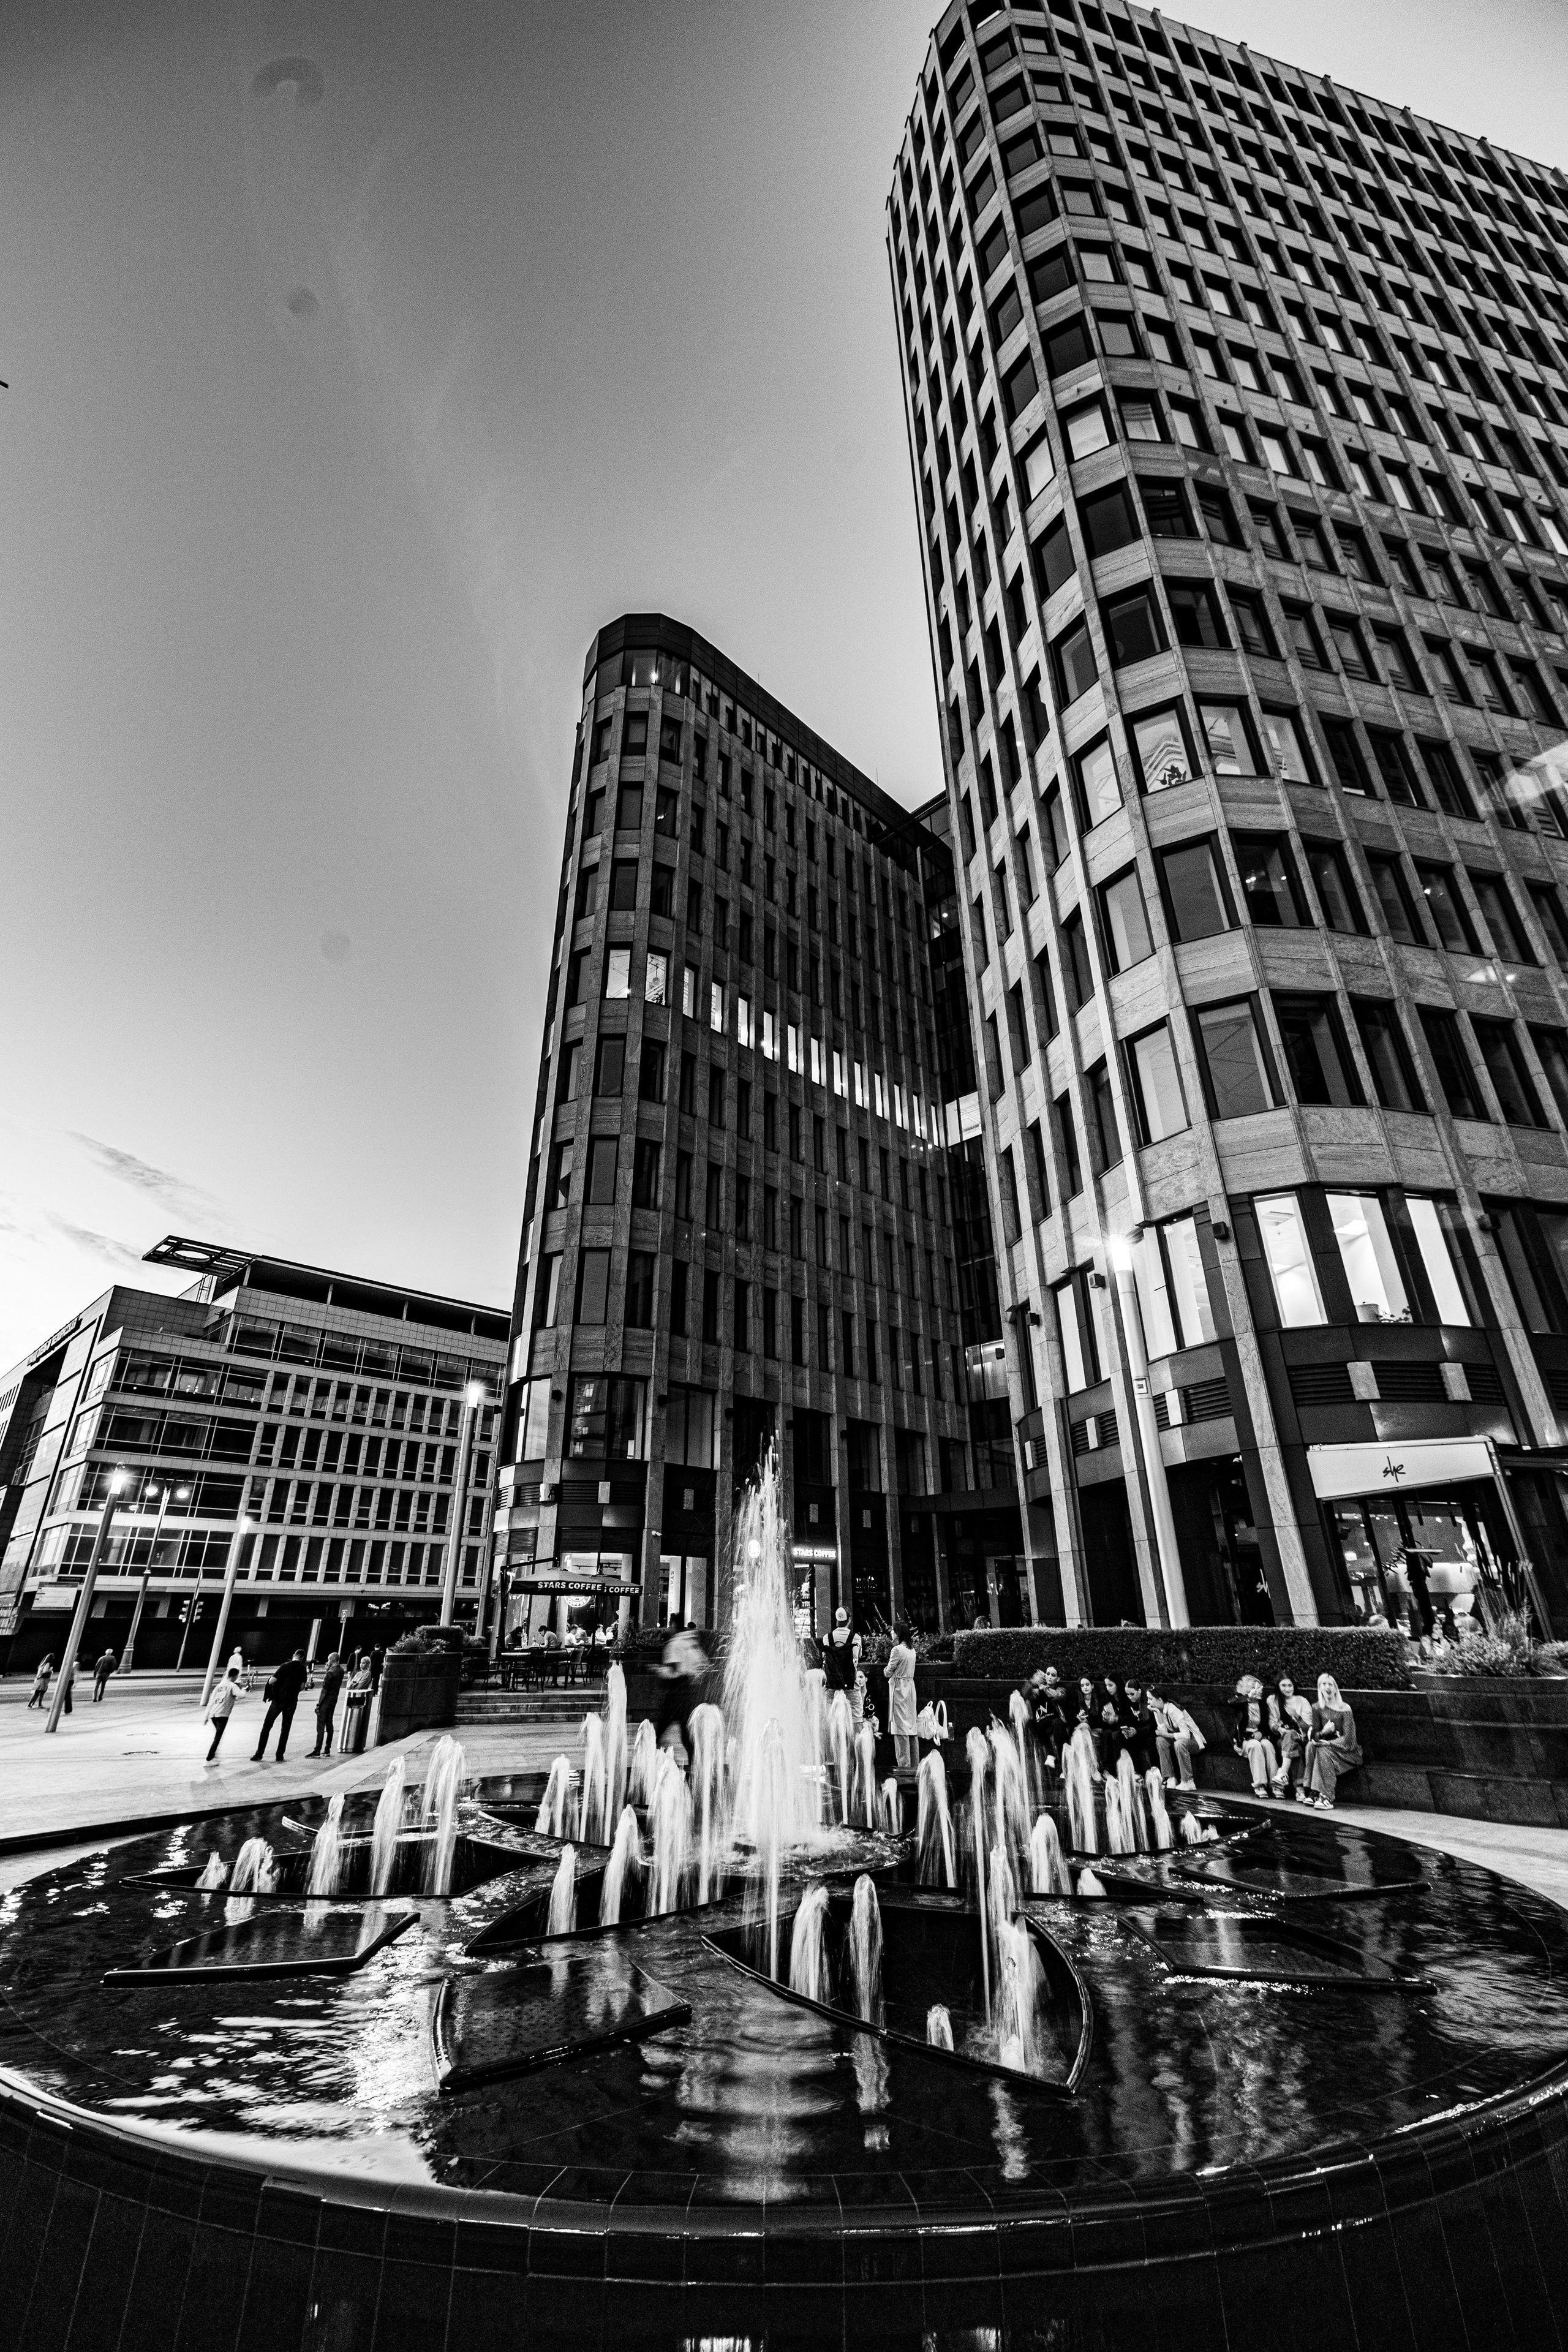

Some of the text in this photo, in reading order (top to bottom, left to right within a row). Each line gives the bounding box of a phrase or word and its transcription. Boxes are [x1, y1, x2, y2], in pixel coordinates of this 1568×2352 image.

[1382, 1455, 1406, 1483] she
[794, 1548, 813, 1557] STARS
[568, 1582, 601, 1591] COFFEE
[1256, 1568, 1271, 1599] sh
